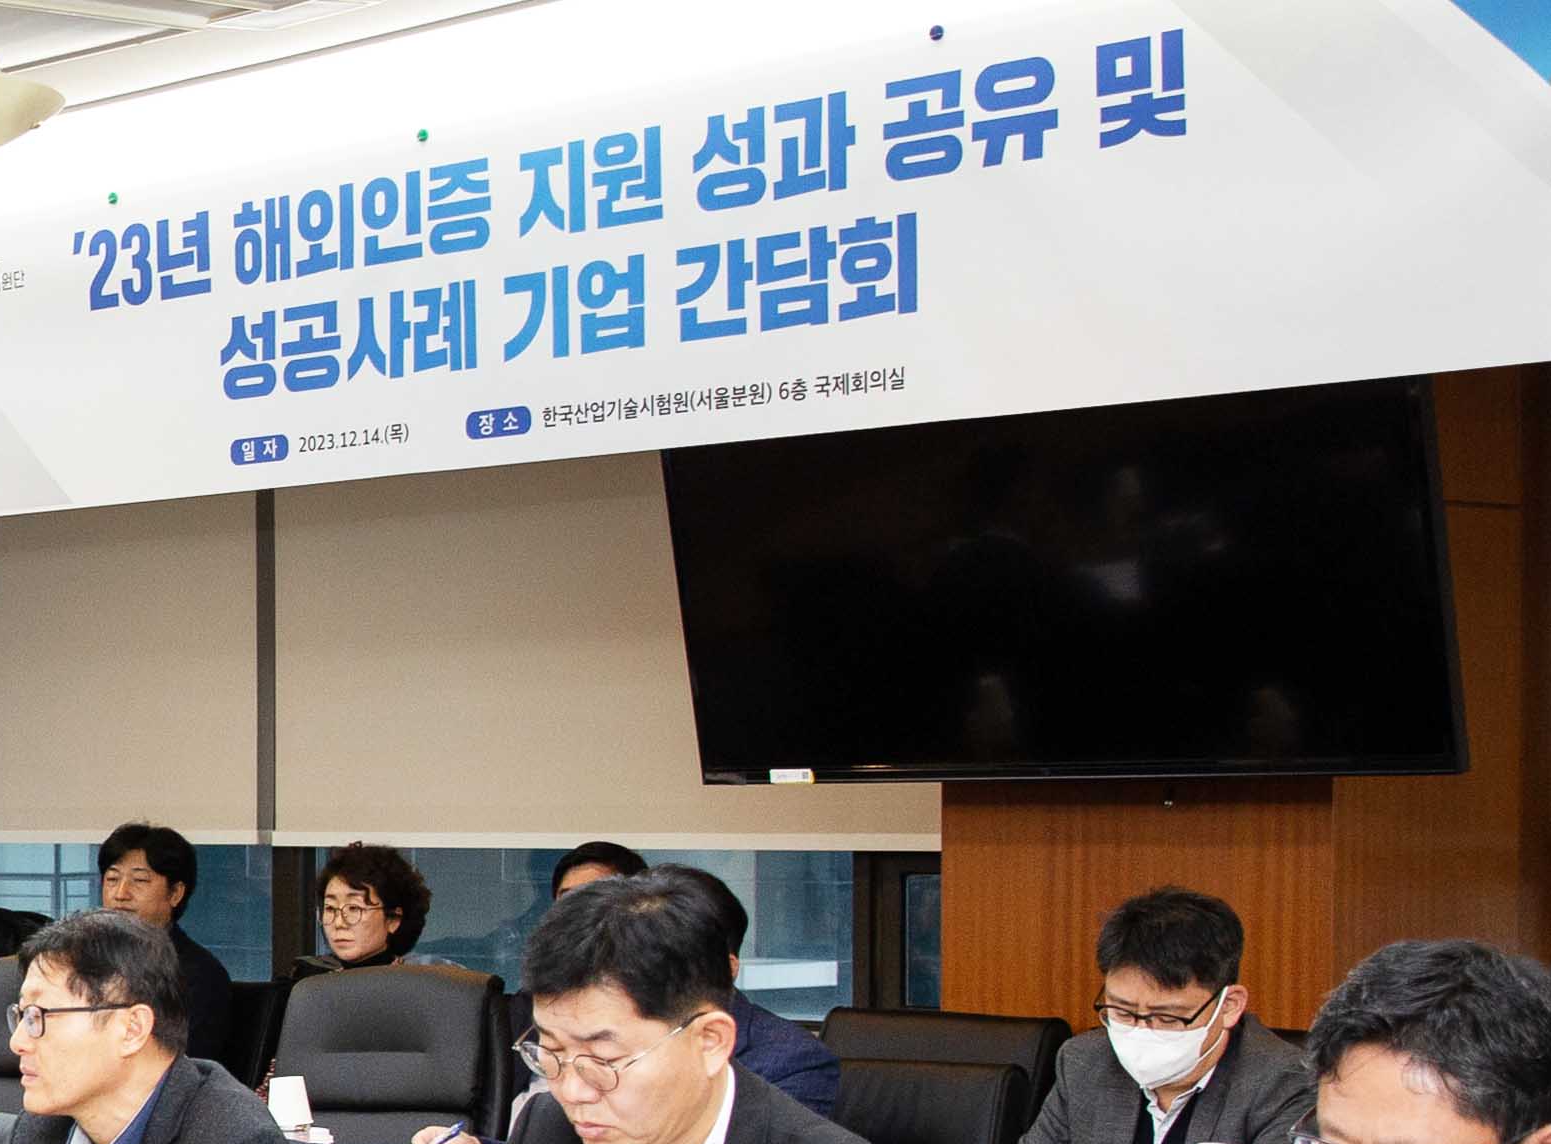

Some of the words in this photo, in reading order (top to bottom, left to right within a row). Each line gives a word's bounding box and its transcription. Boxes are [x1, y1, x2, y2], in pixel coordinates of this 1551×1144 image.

[232, 157, 492, 285] 해외인증
[518, 125, 662, 240] 지원
[692, 88, 856, 212] 성과
[882, 56, 1059, 182] 공유
[1096, 28, 1188, 149] 및
[219, 279, 477, 400] 성공사례
[502, 253, 645, 363] 기업
[674, 212, 919, 343] 간담회
[298, 422, 409, 455] 2023.12.14.(목)
[542, 382, 772, 428] 한국산업기술시험원(서울분원)
[778, 376, 808, 402] 6층
[814, 364, 907, 397] 국제회의실
